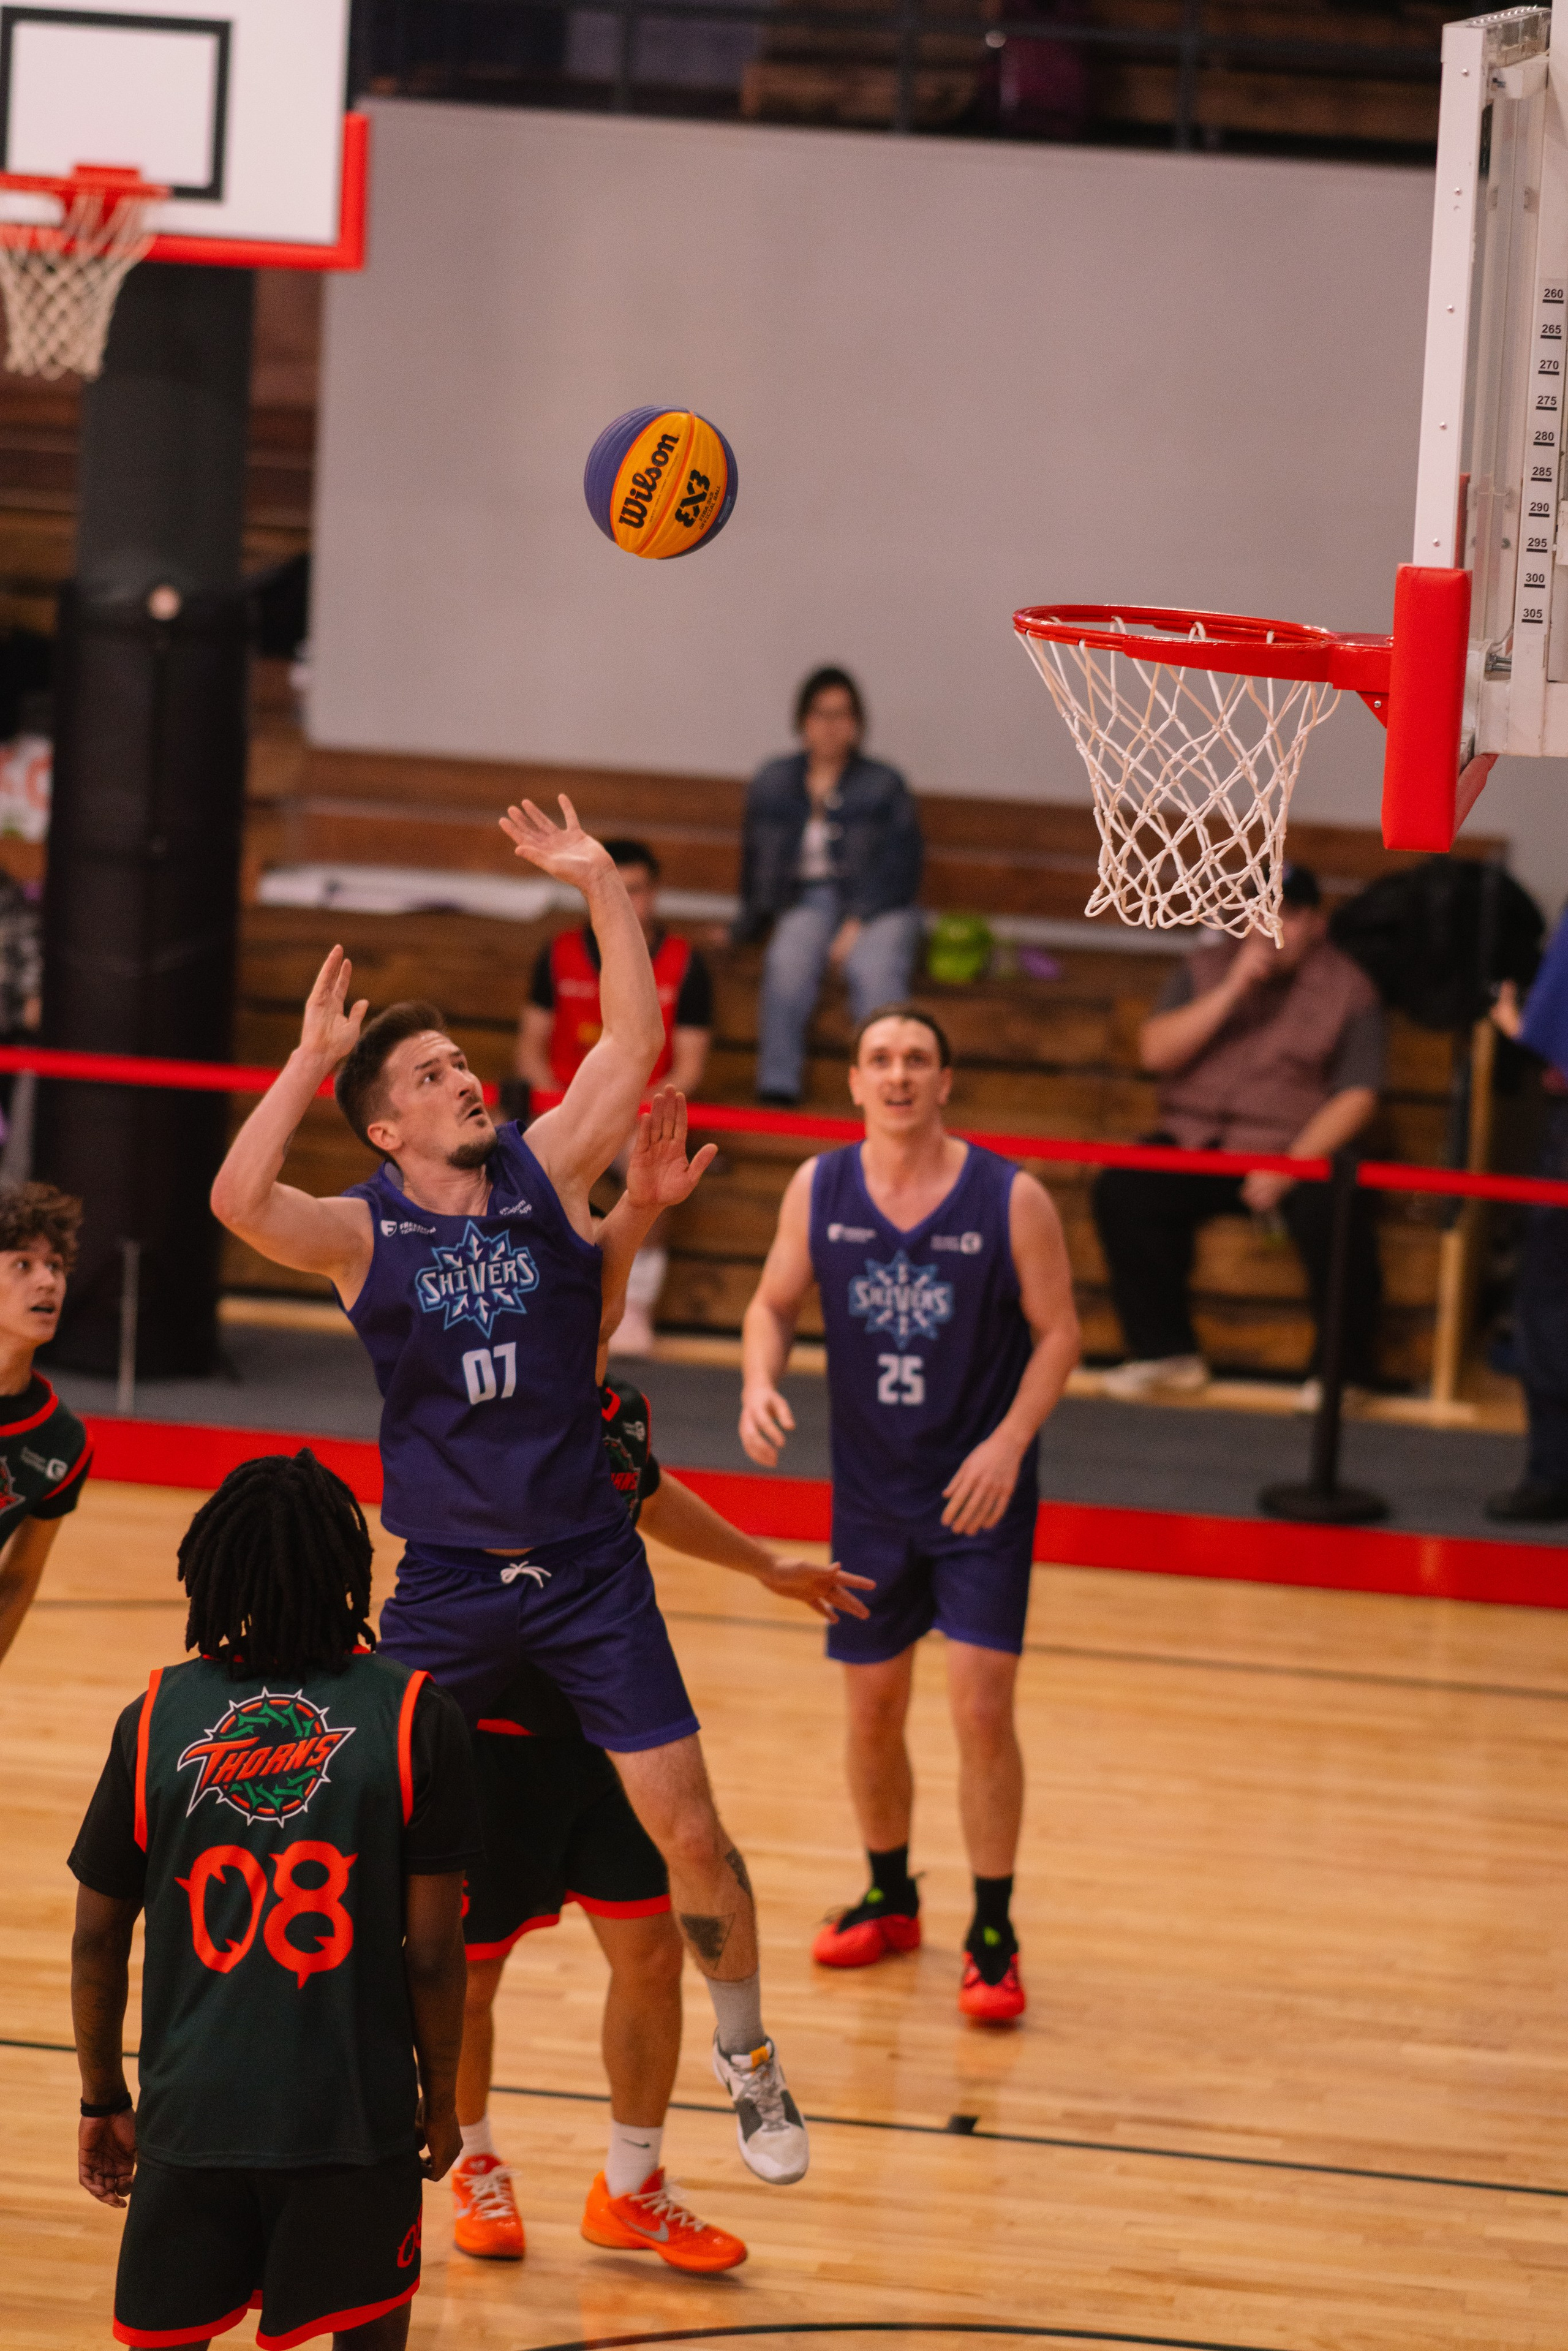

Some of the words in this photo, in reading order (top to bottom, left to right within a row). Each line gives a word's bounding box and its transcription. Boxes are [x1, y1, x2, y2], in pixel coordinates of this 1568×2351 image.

[1544, 288, 1564, 299] 260
[1541, 323, 1562, 334] 265
[1539, 359, 1559, 370] 270
[1537, 395, 1558, 406] 275
[1534, 431, 1555, 441] 280
[1532, 466, 1552, 477] 285
[619, 434, 679, 529] Wilson
[1529, 502, 1550, 512] 290
[1527, 537, 1548, 548] 295
[1525, 573, 1545, 583] 300
[1523, 608, 1543, 619] 305
[421, 1253, 534, 1303] SHIVERS
[462, 1342, 516, 1405] 07
[877, 1353, 925, 1405] 25
[186, 1734, 342, 1791] THORNS
[174, 1840, 358, 1989] 08
